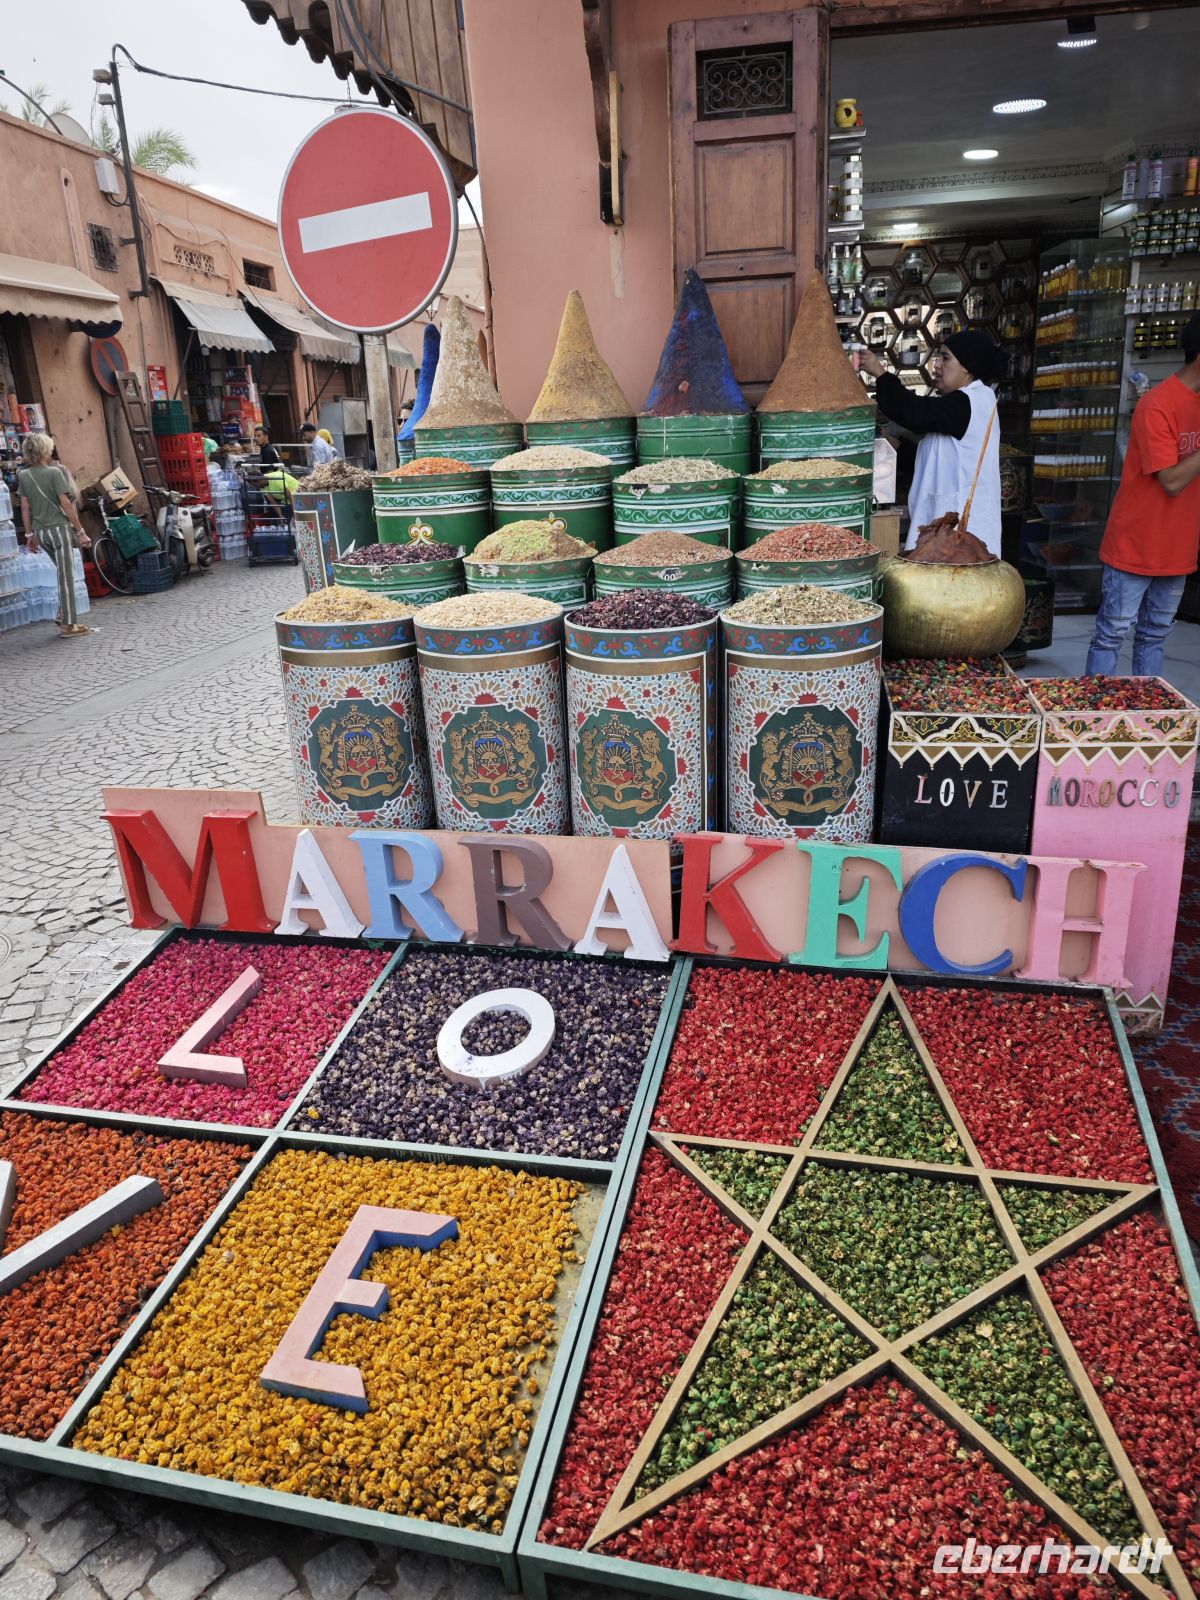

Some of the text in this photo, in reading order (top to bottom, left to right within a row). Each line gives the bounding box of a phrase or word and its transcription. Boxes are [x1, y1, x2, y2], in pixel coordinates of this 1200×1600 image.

[915, 774, 1008, 809] LOVE
[1046, 776, 1181, 808] MOROCCO
[101, 808, 1148, 988] MARRAKECH
